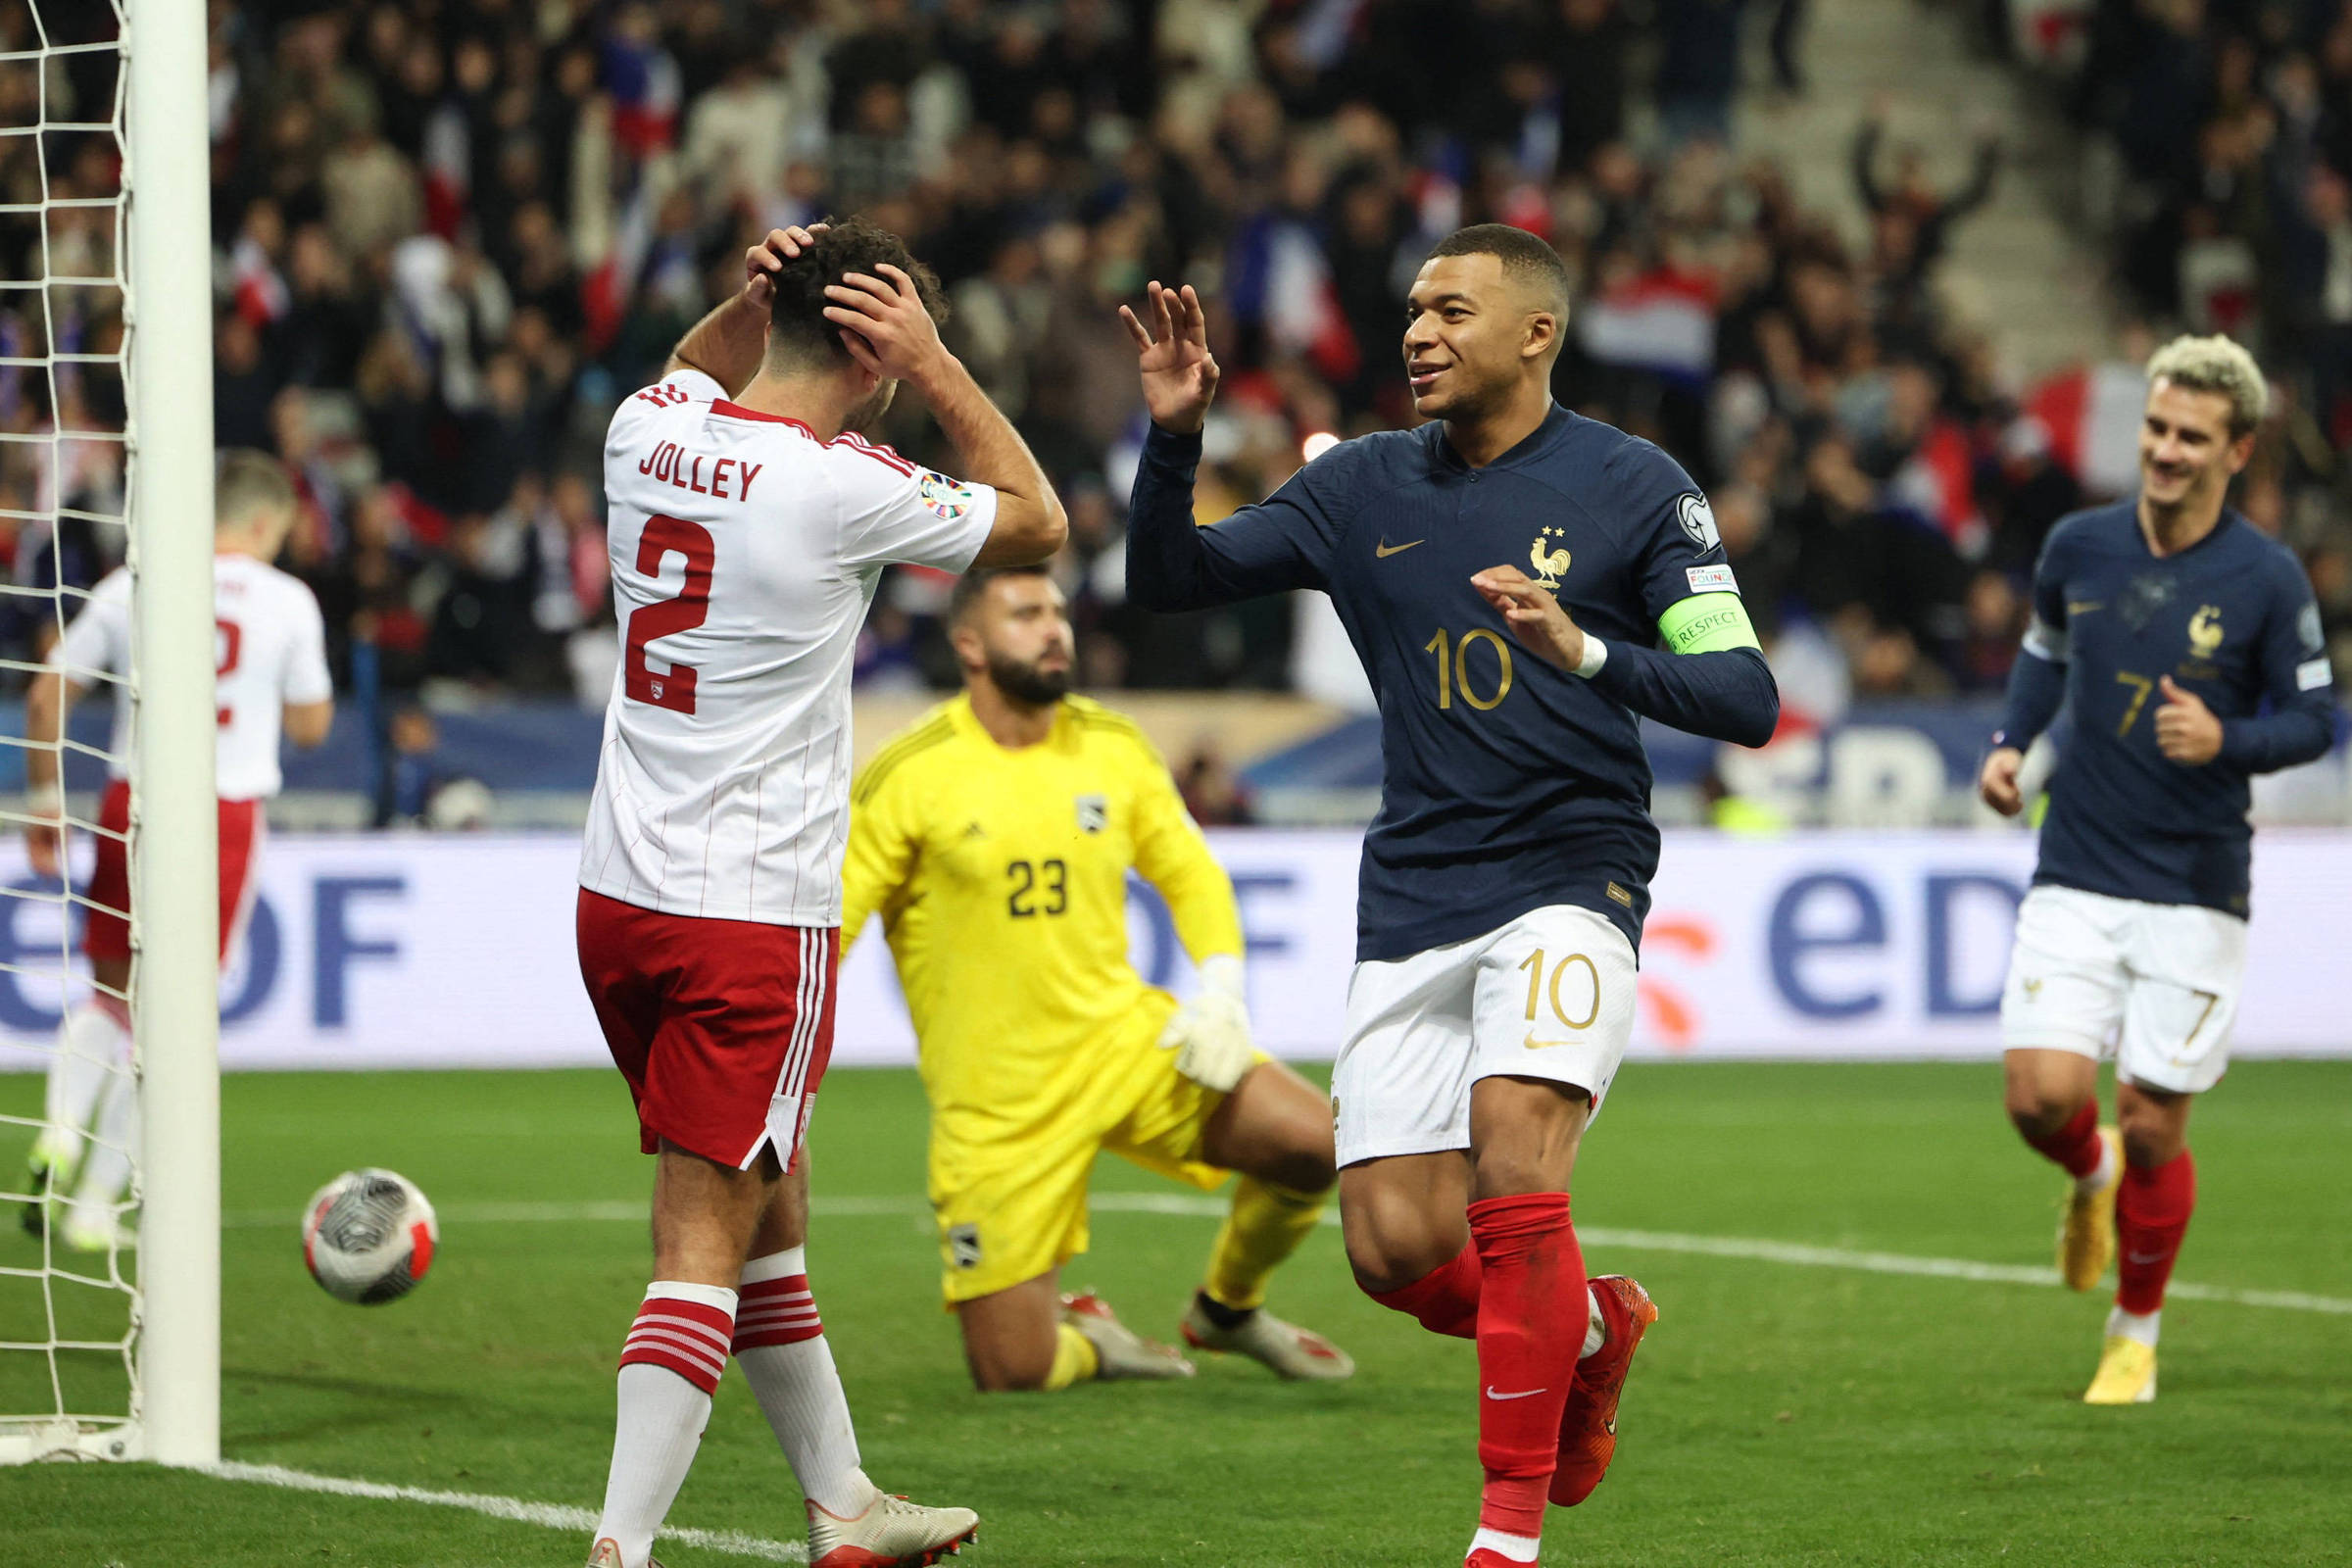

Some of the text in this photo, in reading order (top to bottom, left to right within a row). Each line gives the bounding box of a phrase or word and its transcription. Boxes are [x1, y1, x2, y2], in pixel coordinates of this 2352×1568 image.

[639, 440, 762, 502] JOLLEY
[625, 514, 714, 715] 2
[1679, 612, 1739, 644] RESPECT
[1425, 627, 1512, 710] 10
[2116, 670, 2153, 737] 7
[1007, 859, 1066, 916] 23
[1519, 948, 1599, 1029] 10
[2191, 988, 2219, 1047] 7
